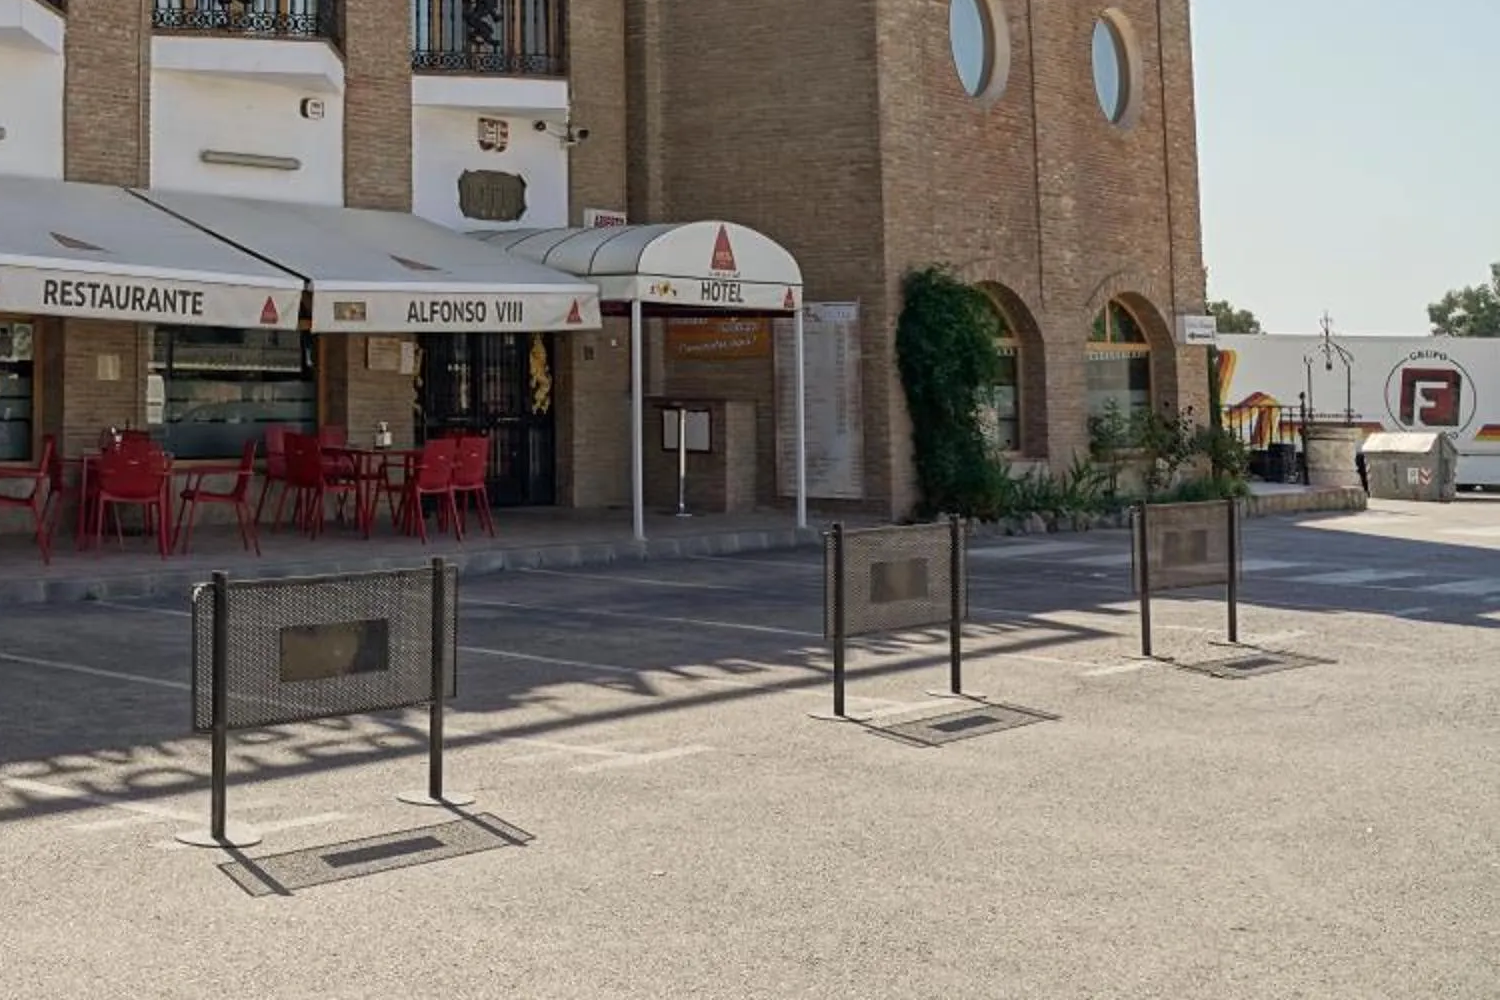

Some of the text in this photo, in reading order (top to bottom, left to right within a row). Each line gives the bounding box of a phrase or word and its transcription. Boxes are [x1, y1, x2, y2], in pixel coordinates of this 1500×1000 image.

[43, 279, 204, 315] RESTAURANTE
[701, 282, 744, 303] HOTEL
[407, 301, 523, 323] ALFONSO VIII
[1409, 350, 1448, 361] GRUPO
